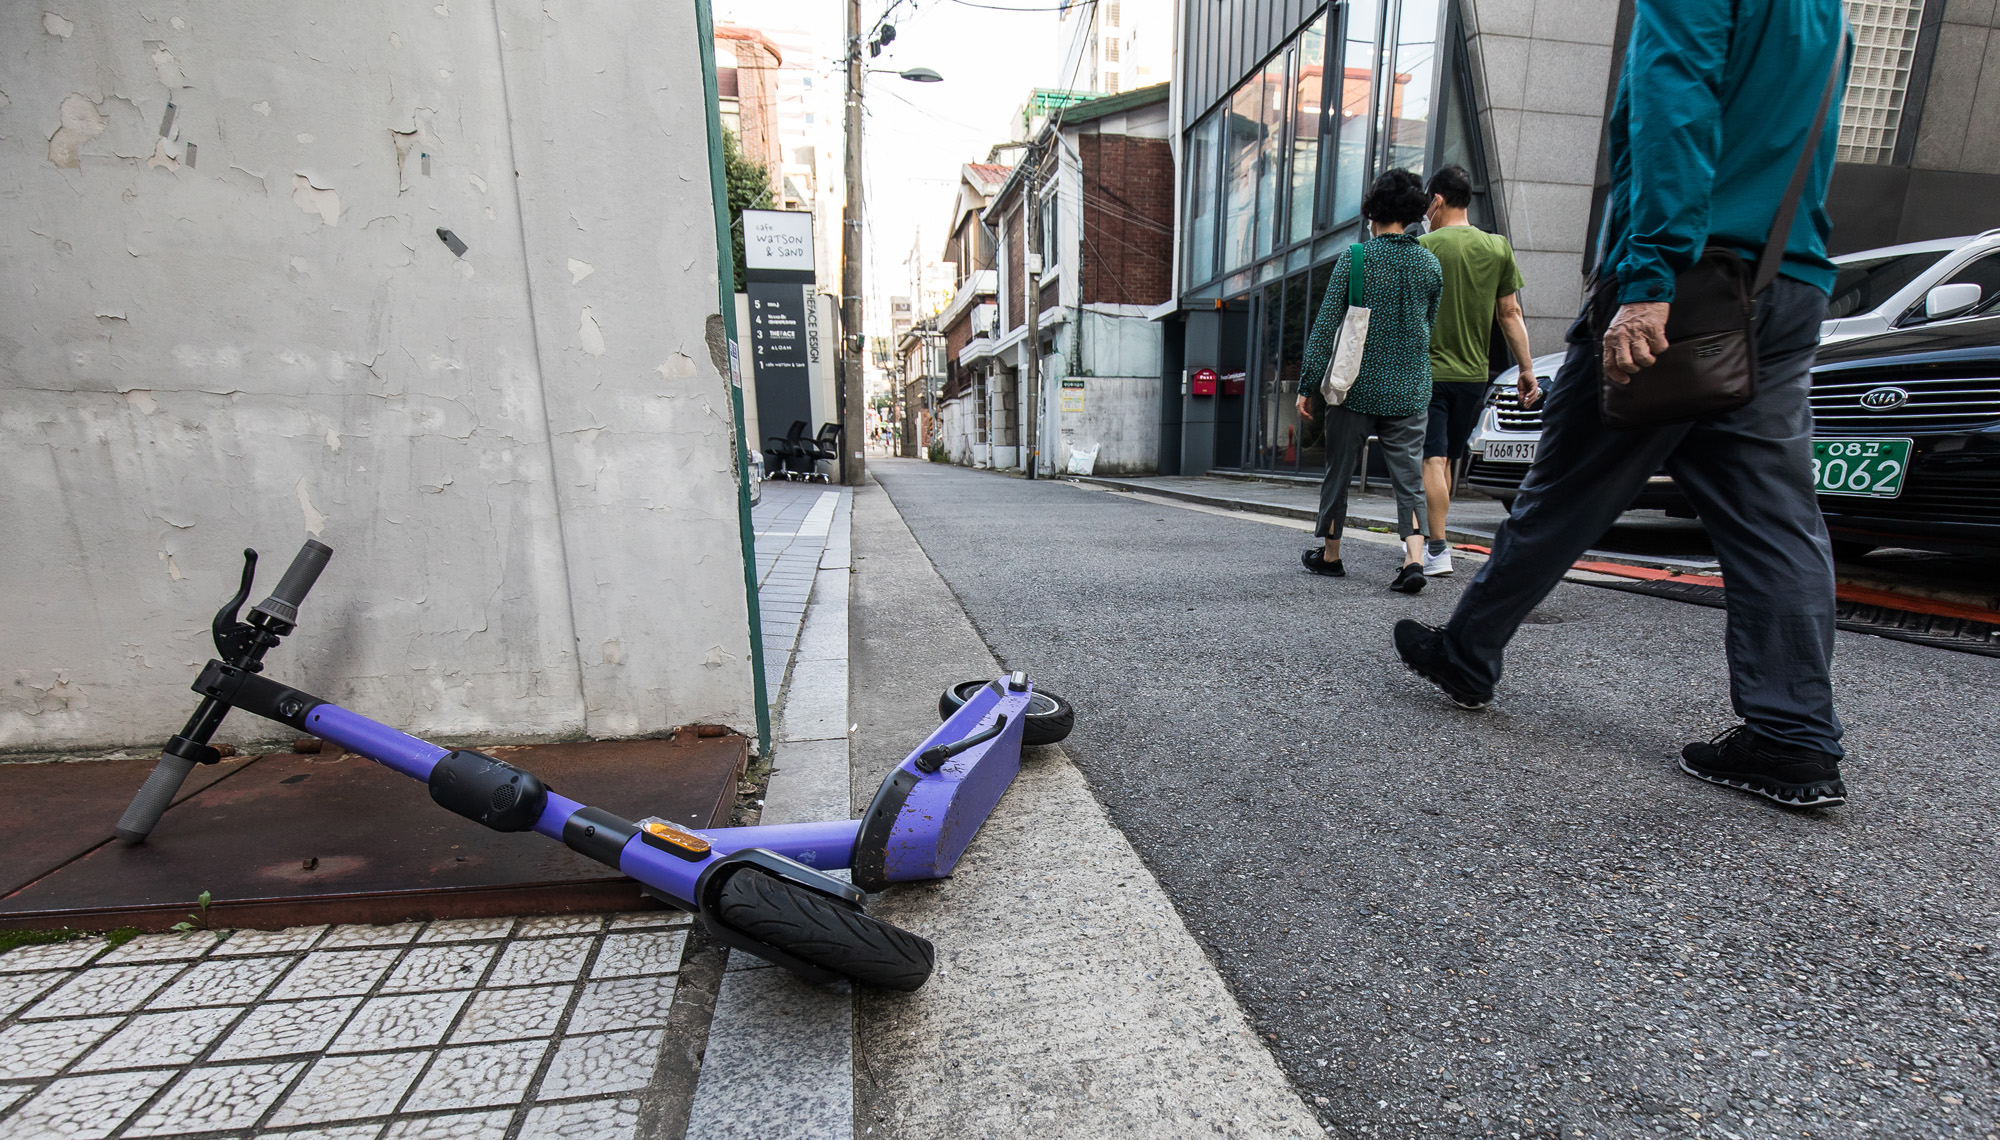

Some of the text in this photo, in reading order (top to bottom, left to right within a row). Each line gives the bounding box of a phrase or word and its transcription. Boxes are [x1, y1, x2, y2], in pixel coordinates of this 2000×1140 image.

[766, 246, 773, 257] &
[754, 299, 762, 309] 5
[755, 315, 763, 325] 4
[756, 330, 764, 339] 3
[757, 345, 765, 355] 2
[808, 330, 820, 364] DESIGN
[759, 361, 765, 370] 1
[1866, 393, 1896, 405] KIA
[1515, 443, 1536, 459] 931
[1828, 442, 1880, 457] 08고
